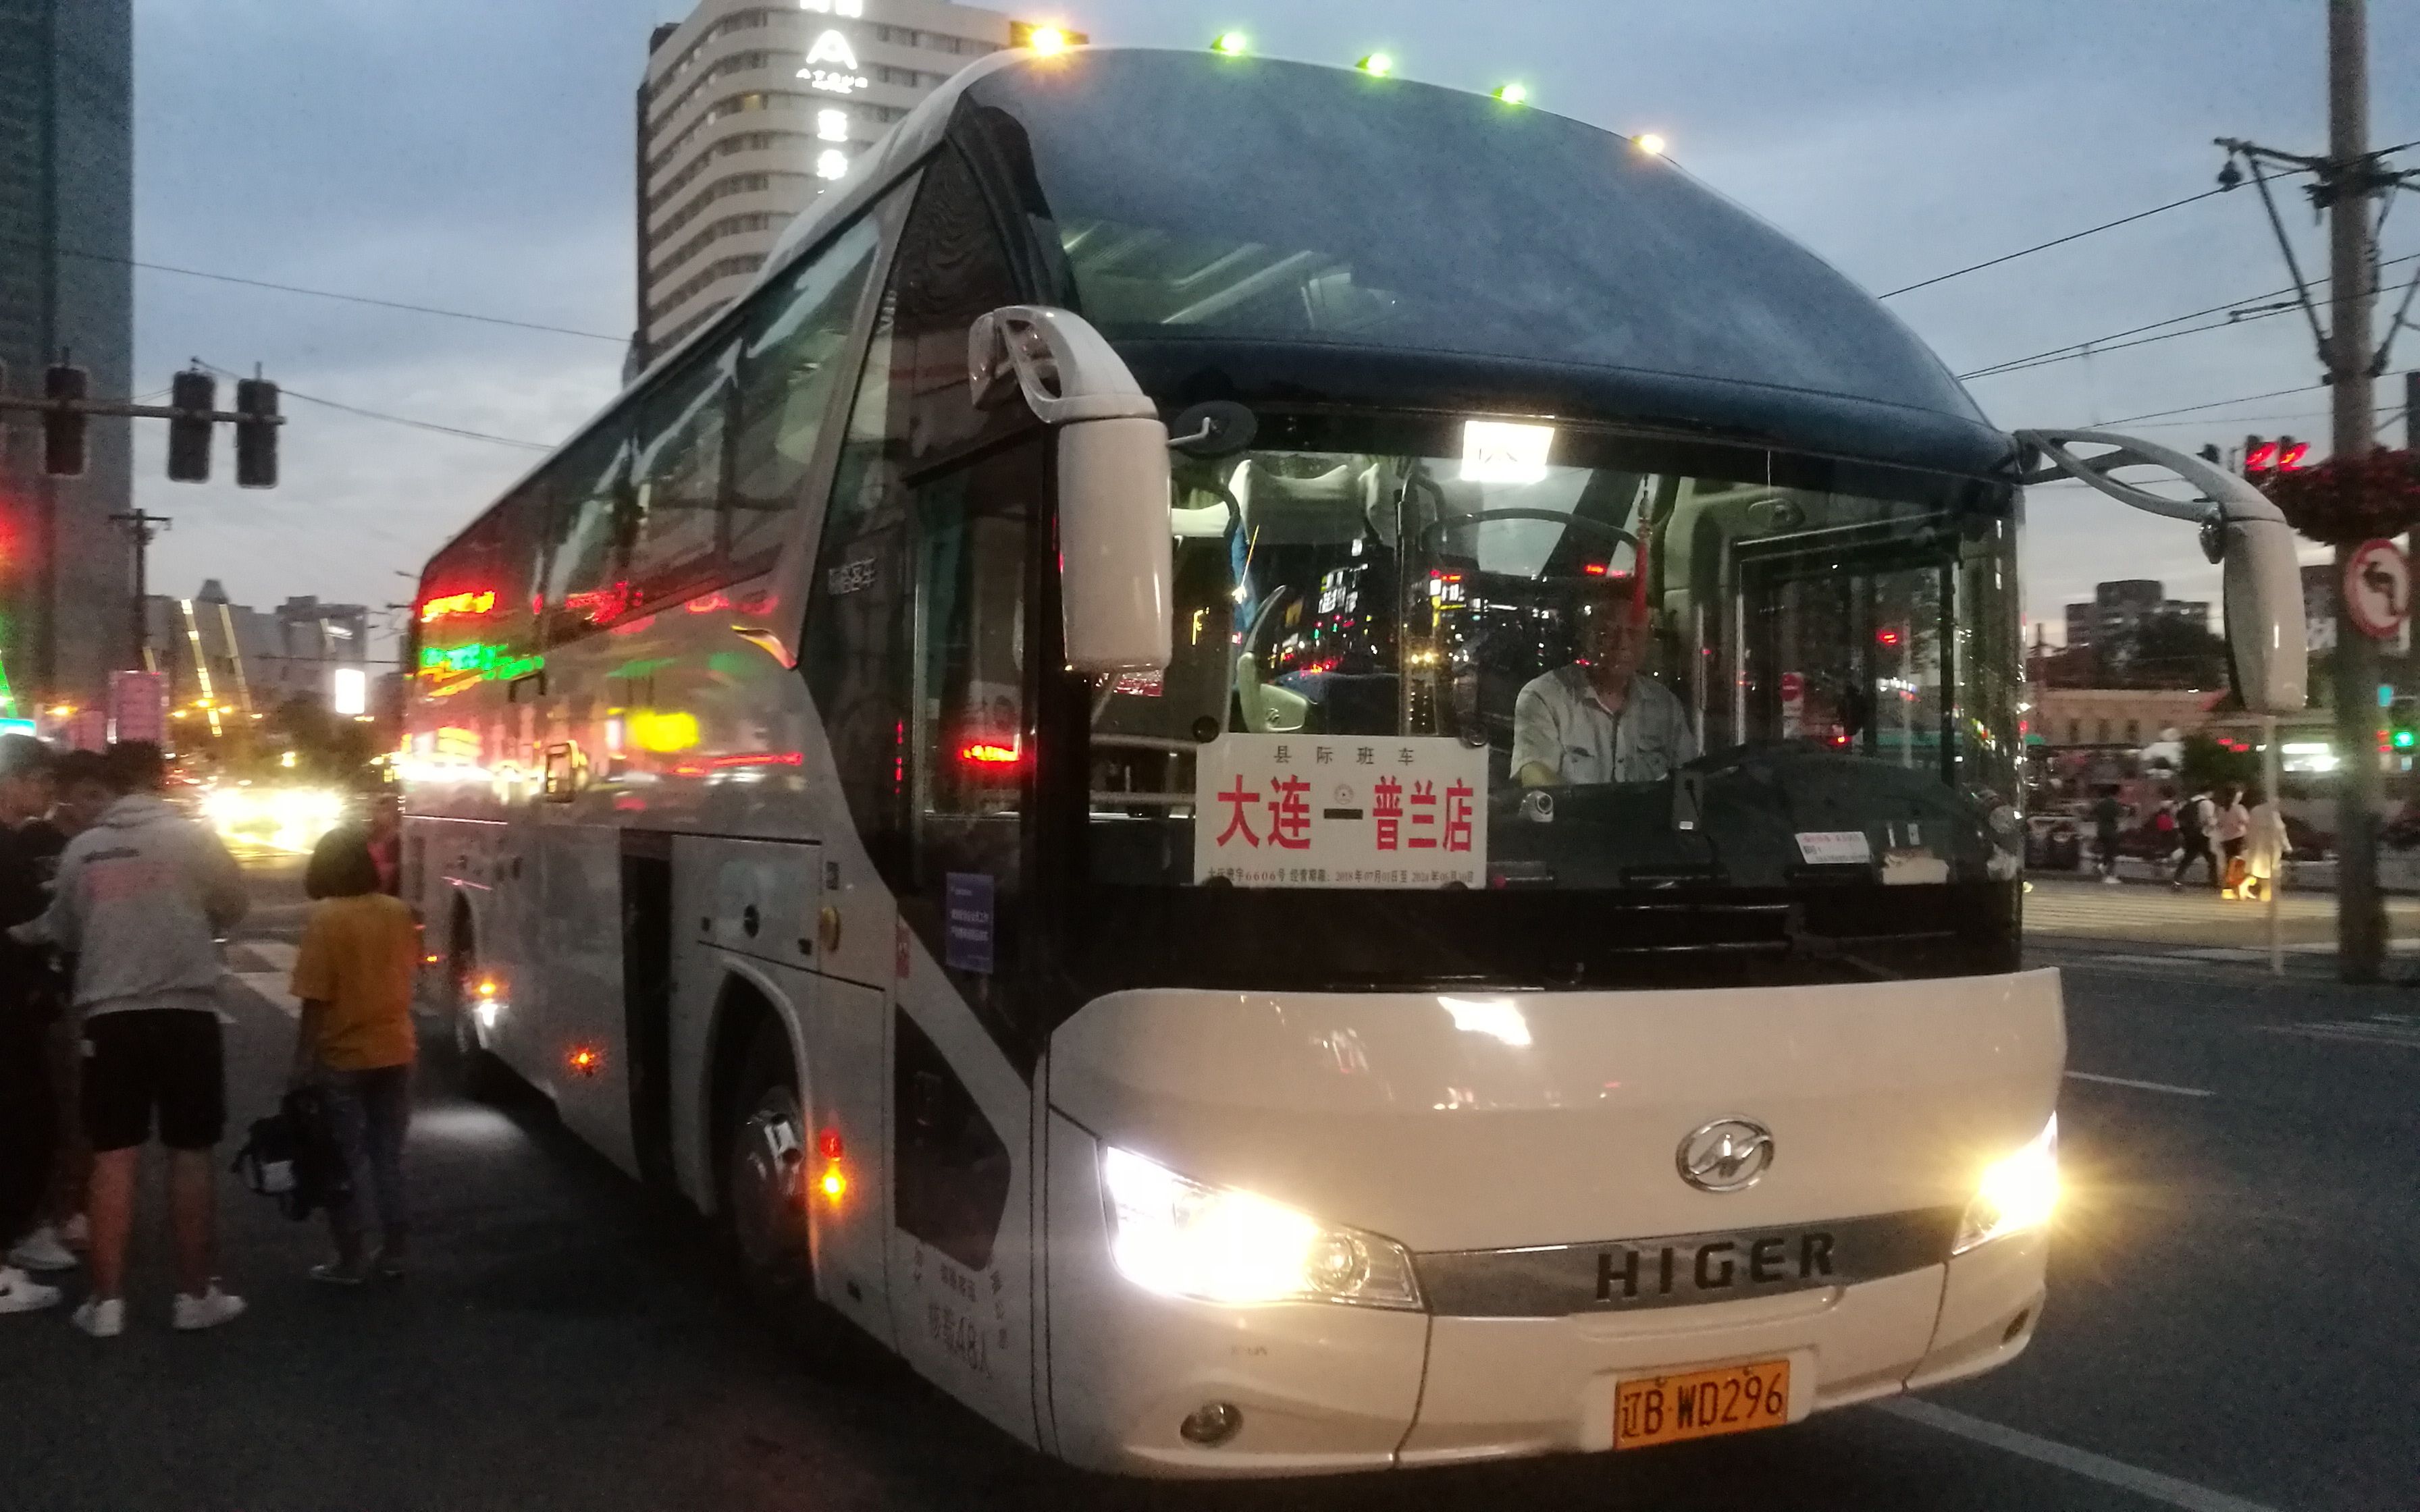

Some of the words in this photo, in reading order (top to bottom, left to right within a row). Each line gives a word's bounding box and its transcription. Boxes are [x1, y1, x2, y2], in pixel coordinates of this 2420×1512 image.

[1273, 745, 1415, 766] 县际班车
[1596, 1232, 1835, 1302] HIGER
